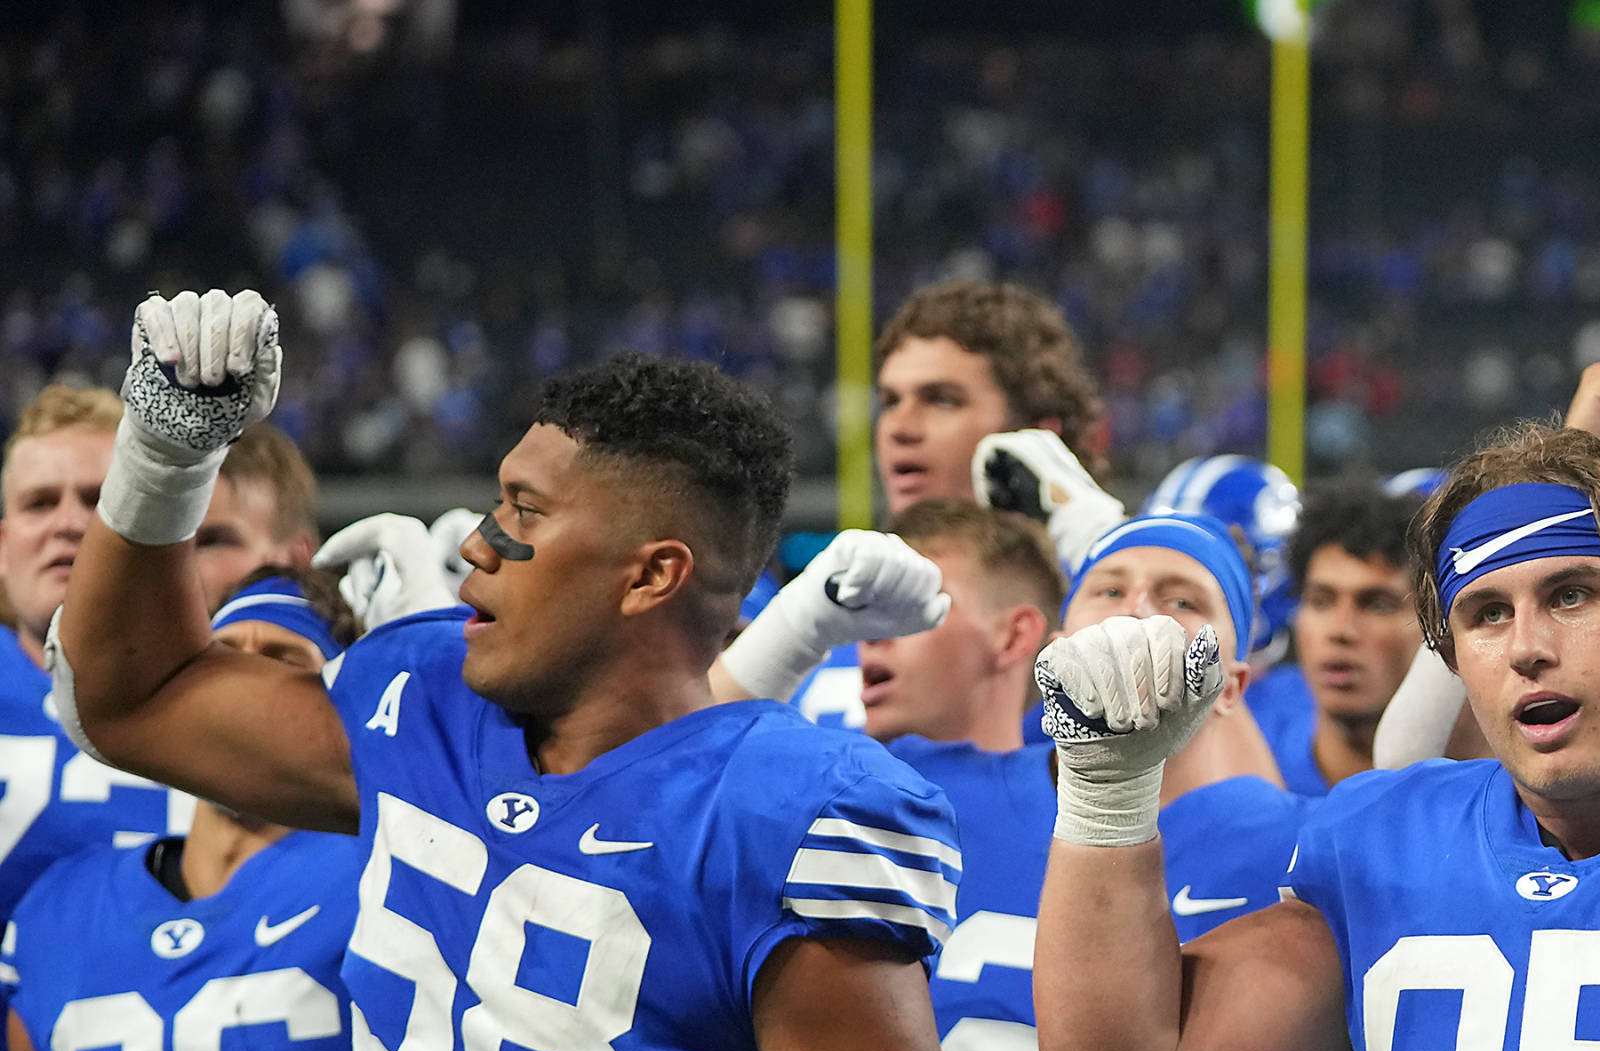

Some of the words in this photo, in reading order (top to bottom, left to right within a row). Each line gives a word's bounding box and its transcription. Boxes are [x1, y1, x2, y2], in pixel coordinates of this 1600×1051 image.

[366, 671, 411, 737] A
[500, 799, 534, 828] Y
[1529, 875, 1570, 896] Y
[162, 927, 193, 950] Y
